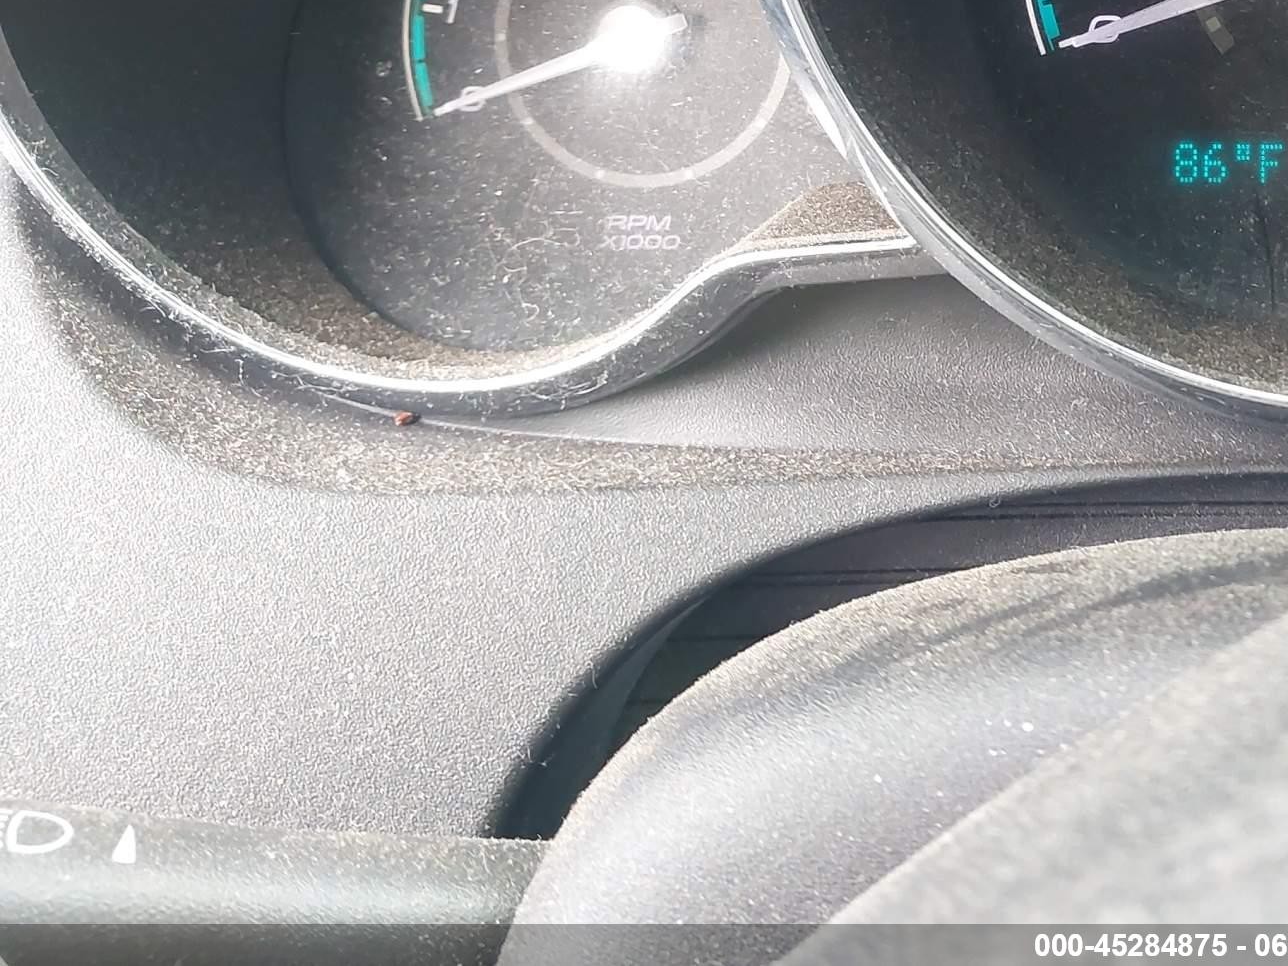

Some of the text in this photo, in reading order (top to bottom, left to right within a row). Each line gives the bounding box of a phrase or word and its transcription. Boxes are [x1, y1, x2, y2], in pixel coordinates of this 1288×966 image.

[1175, 143, 1283, 184] 86°F
[606, 214, 671, 232] RPM
[601, 234, 681, 251] X1000
